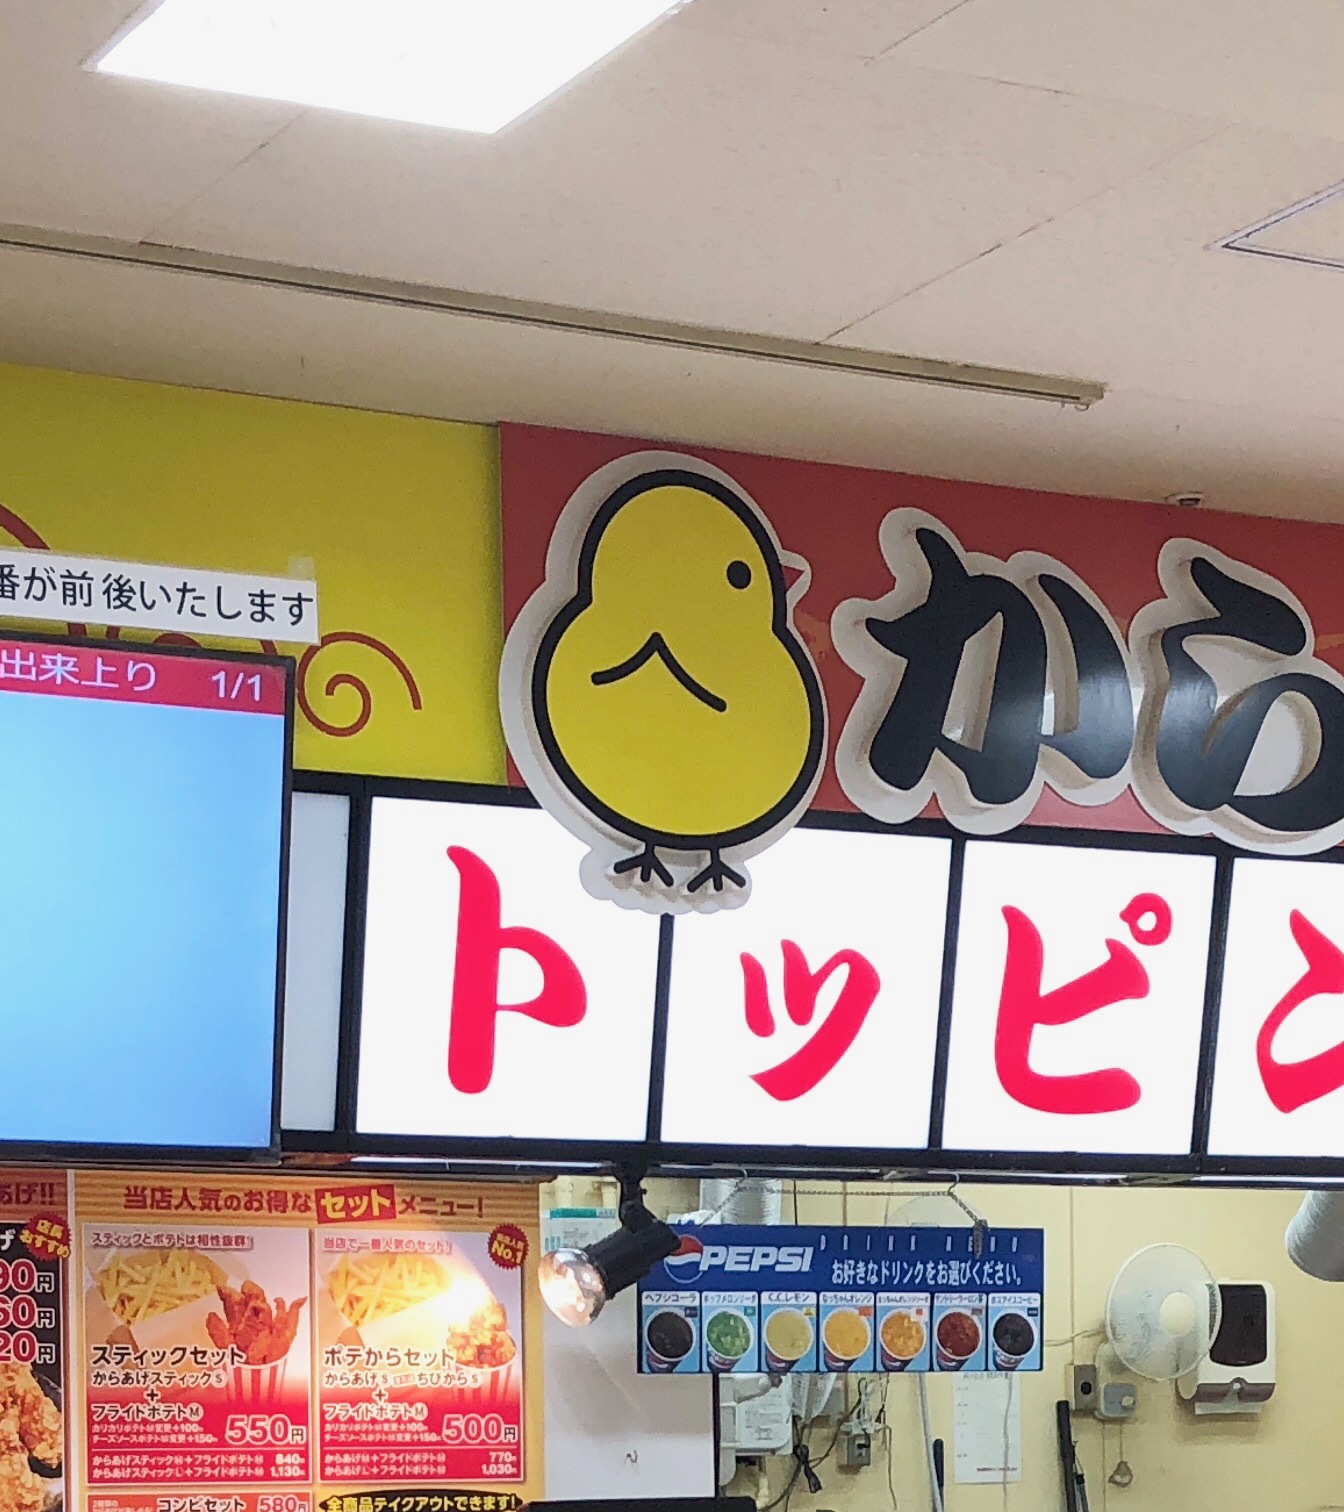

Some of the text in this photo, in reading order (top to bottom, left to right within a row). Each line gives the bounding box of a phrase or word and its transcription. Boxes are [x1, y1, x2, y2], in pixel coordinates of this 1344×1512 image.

[211, 670, 263, 704] 1/1
[701, 1246, 814, 1272] PEPSI
[831, 1261, 1022, 1286] お好きなドリンクをお選びください。
[92, 1345, 246, 1367] スティックセット
[324, 1346, 454, 1368] ポテからセット
[225, 1414, 306, 1445] 550円
[442, 1414, 517, 1444] 500円
[326, 1494, 516, 1512] 全商品テイクアウトできます!
